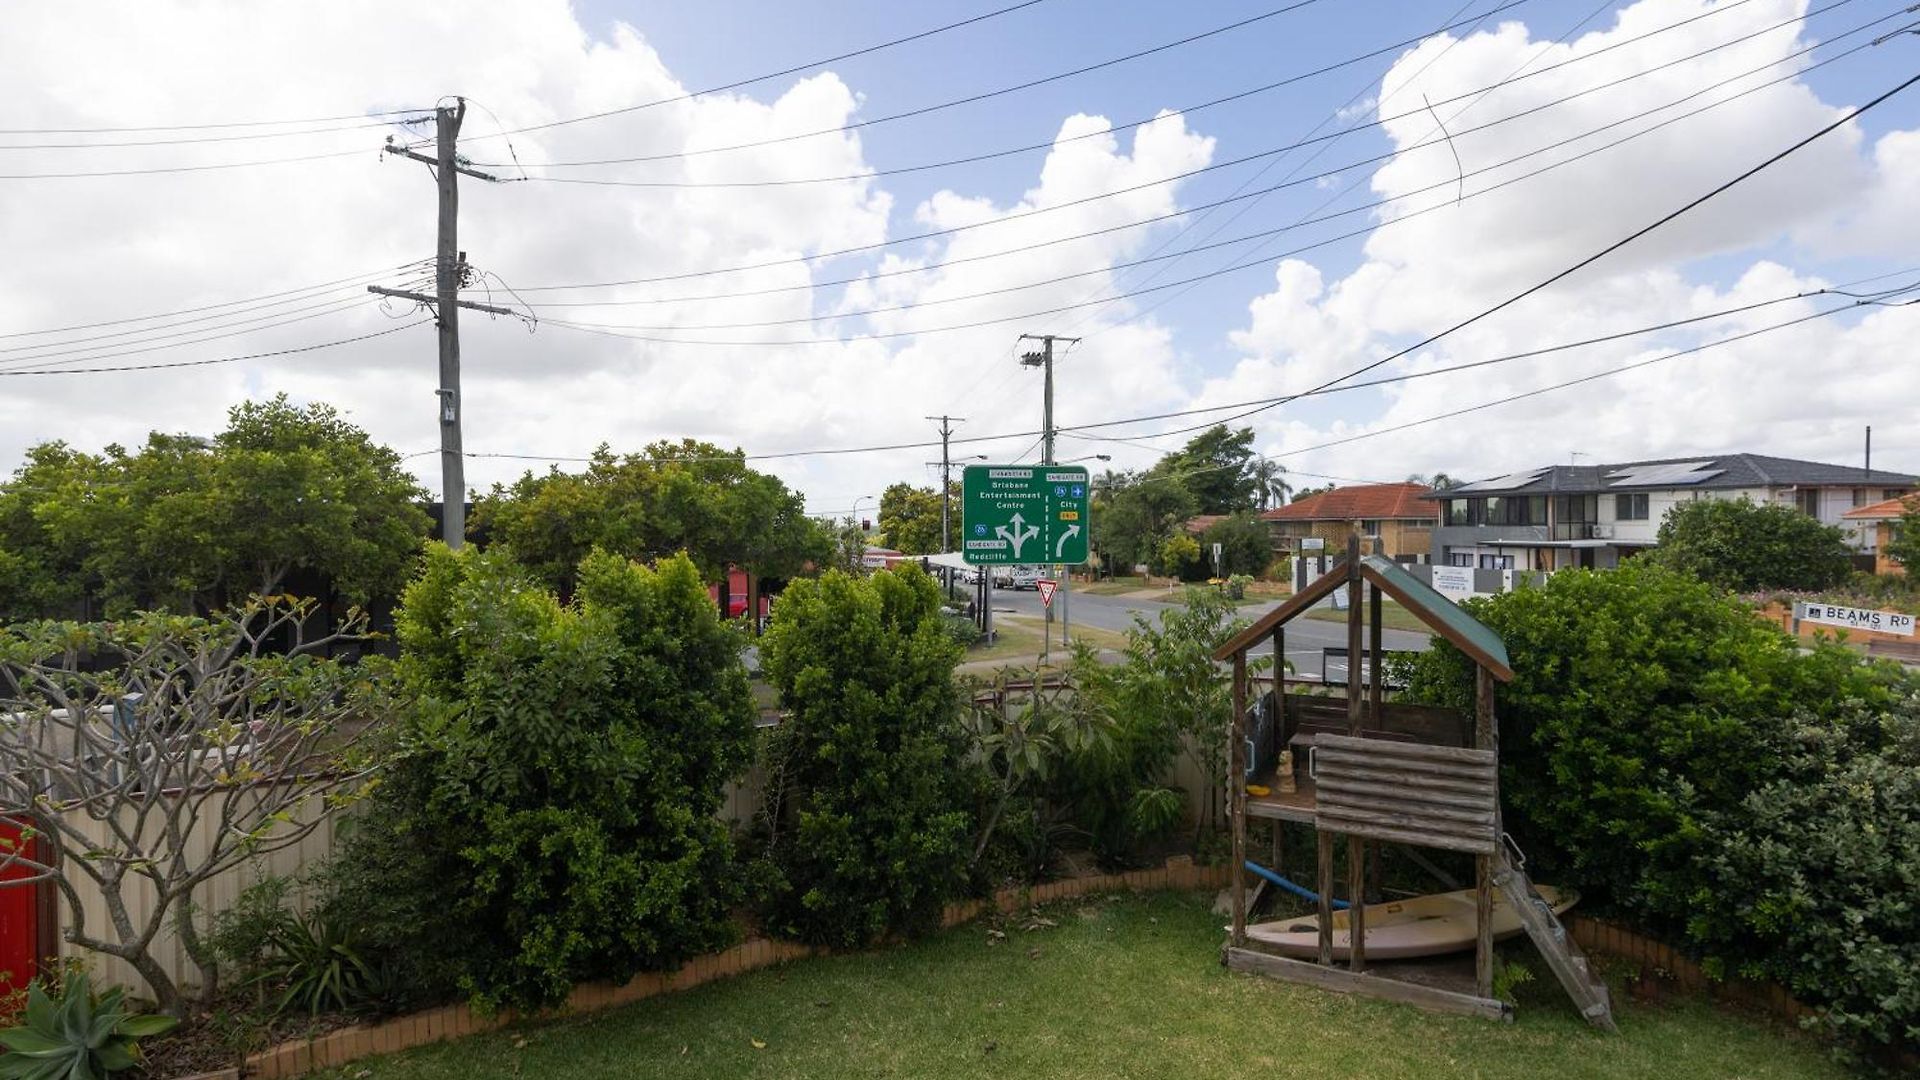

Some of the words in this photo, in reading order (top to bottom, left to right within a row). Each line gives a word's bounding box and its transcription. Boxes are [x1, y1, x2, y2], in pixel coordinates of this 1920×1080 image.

[980, 491, 1041, 499] Entertainment
[996, 501, 1025, 509] Centre
[1060, 501, 1078, 510] City
[1827, 607, 1881, 624] BEAMS
[1890, 616, 1909, 627] RD
